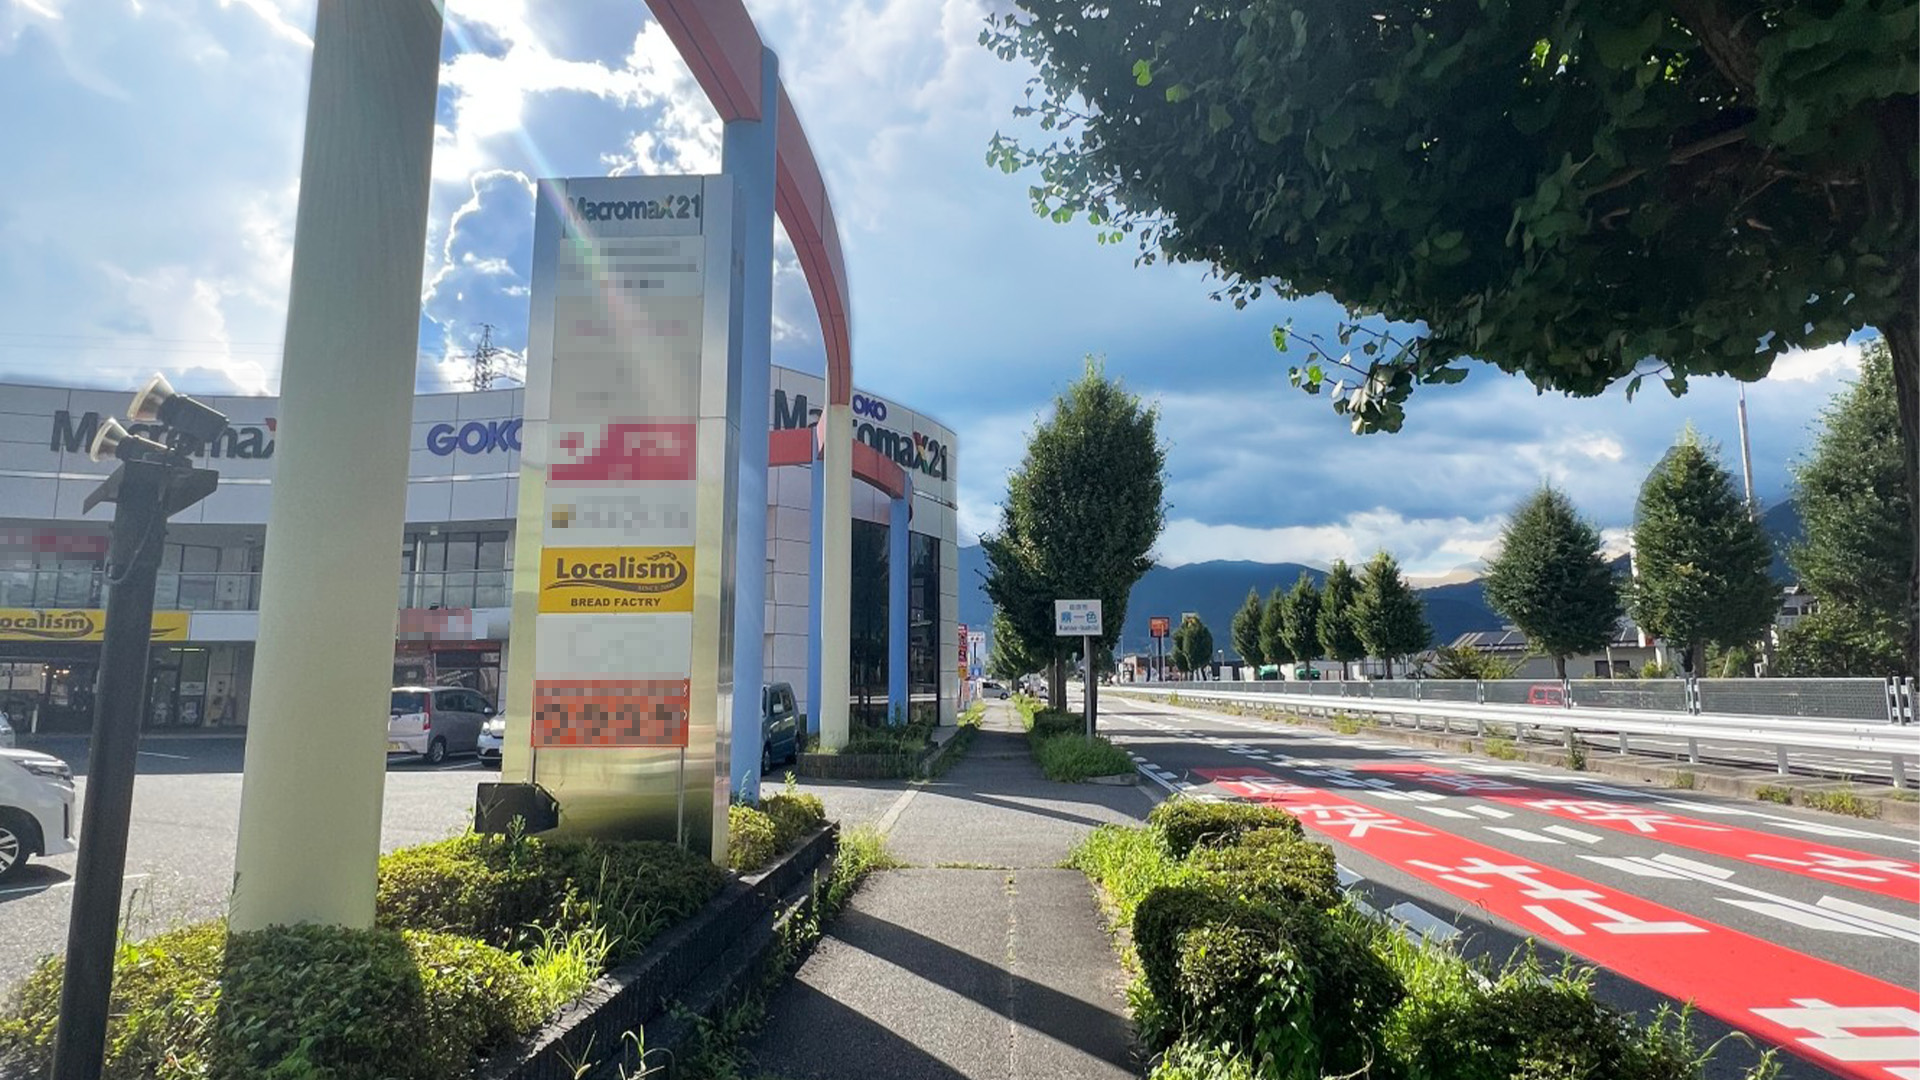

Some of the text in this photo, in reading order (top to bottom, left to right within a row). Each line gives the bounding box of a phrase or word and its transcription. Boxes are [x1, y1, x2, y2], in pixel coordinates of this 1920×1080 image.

[853, 394, 887, 421] OKO
[556, 556, 675, 579] Localism
[570, 597, 662, 607] BREAD FACTRY
[0, 612, 85, 629] ocalism
